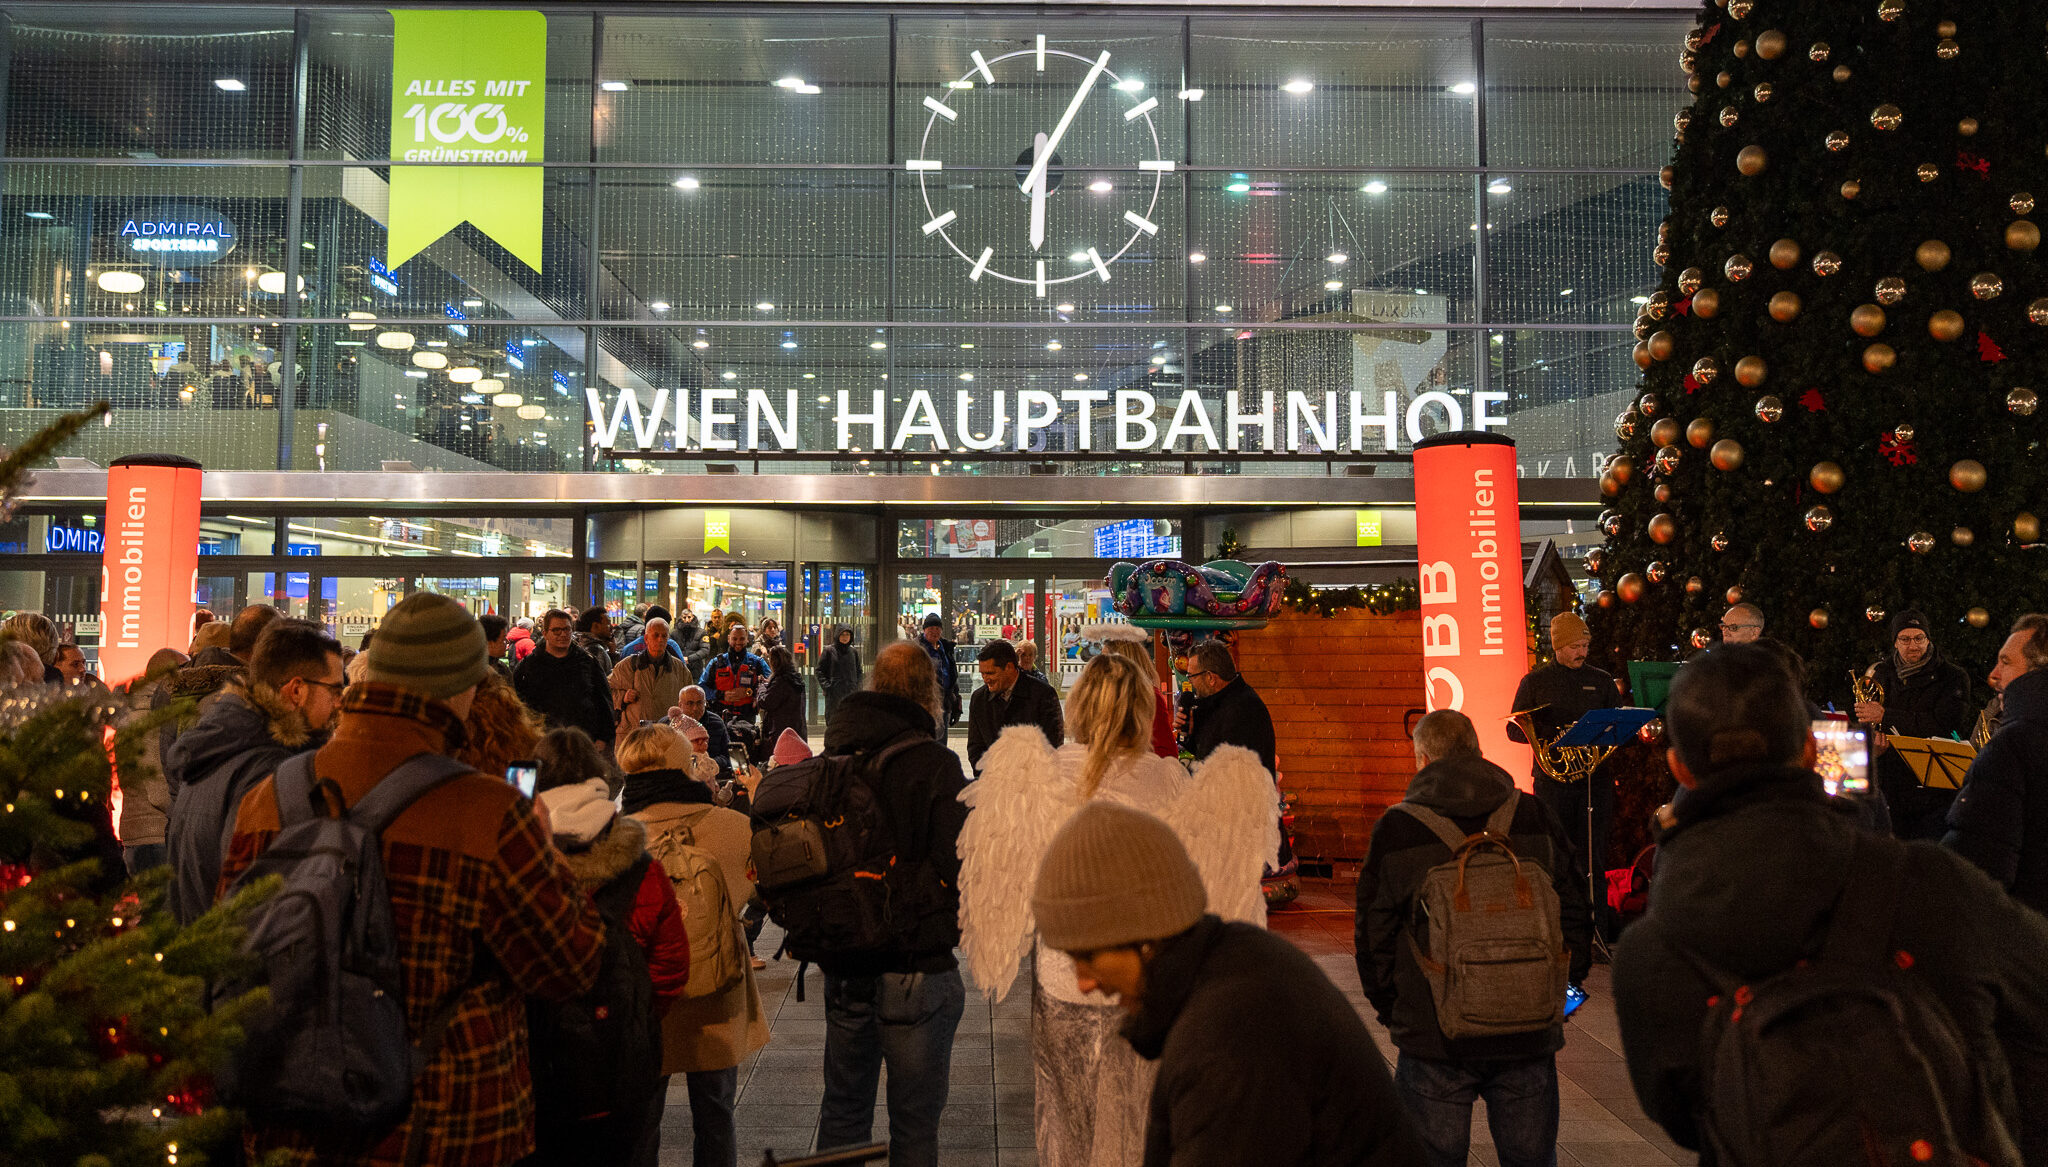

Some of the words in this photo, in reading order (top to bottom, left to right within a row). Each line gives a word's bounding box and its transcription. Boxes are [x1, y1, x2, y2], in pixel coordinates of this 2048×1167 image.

[404, 79, 476, 96] ALLES
[484, 80, 531, 96] MIT
[403, 102, 528, 143] 100%
[404, 146, 527, 162] GRÜNSTROM
[121, 220, 232, 237] ADMIRAL
[585, 387, 798, 450] WIEN
[837, 389, 1509, 451] HAUPTBAHNHOF
[117, 487, 147, 647] Immobilien
[1469, 469, 1504, 655] Immobilien
